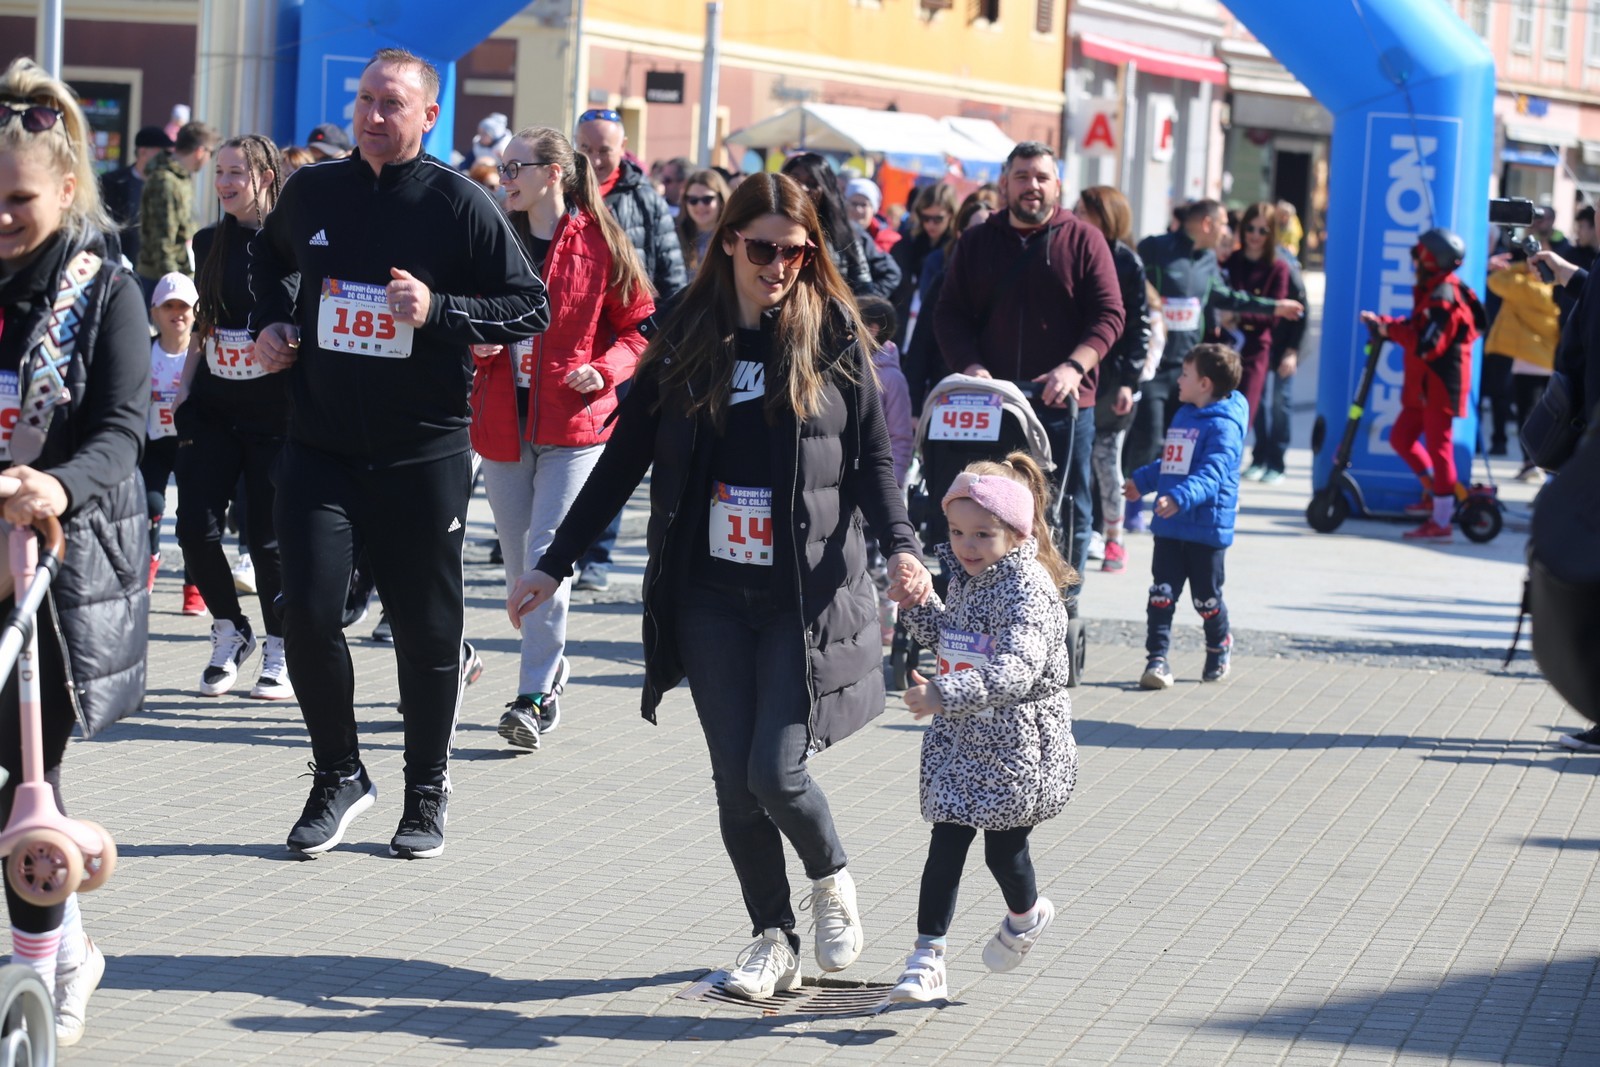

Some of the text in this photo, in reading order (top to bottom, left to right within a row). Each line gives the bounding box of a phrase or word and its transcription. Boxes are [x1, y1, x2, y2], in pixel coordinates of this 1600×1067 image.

[1082, 112, 1115, 150] A
[1367, 134, 1438, 456] DECTHLON
[333, 307, 396, 340] 183
[731, 360, 765, 391] IK
[942, 411, 990, 429] 495
[730, 486, 759, 498] ŠARENIM
[748, 498, 768, 506] CILJA
[728, 514, 772, 546] 14
